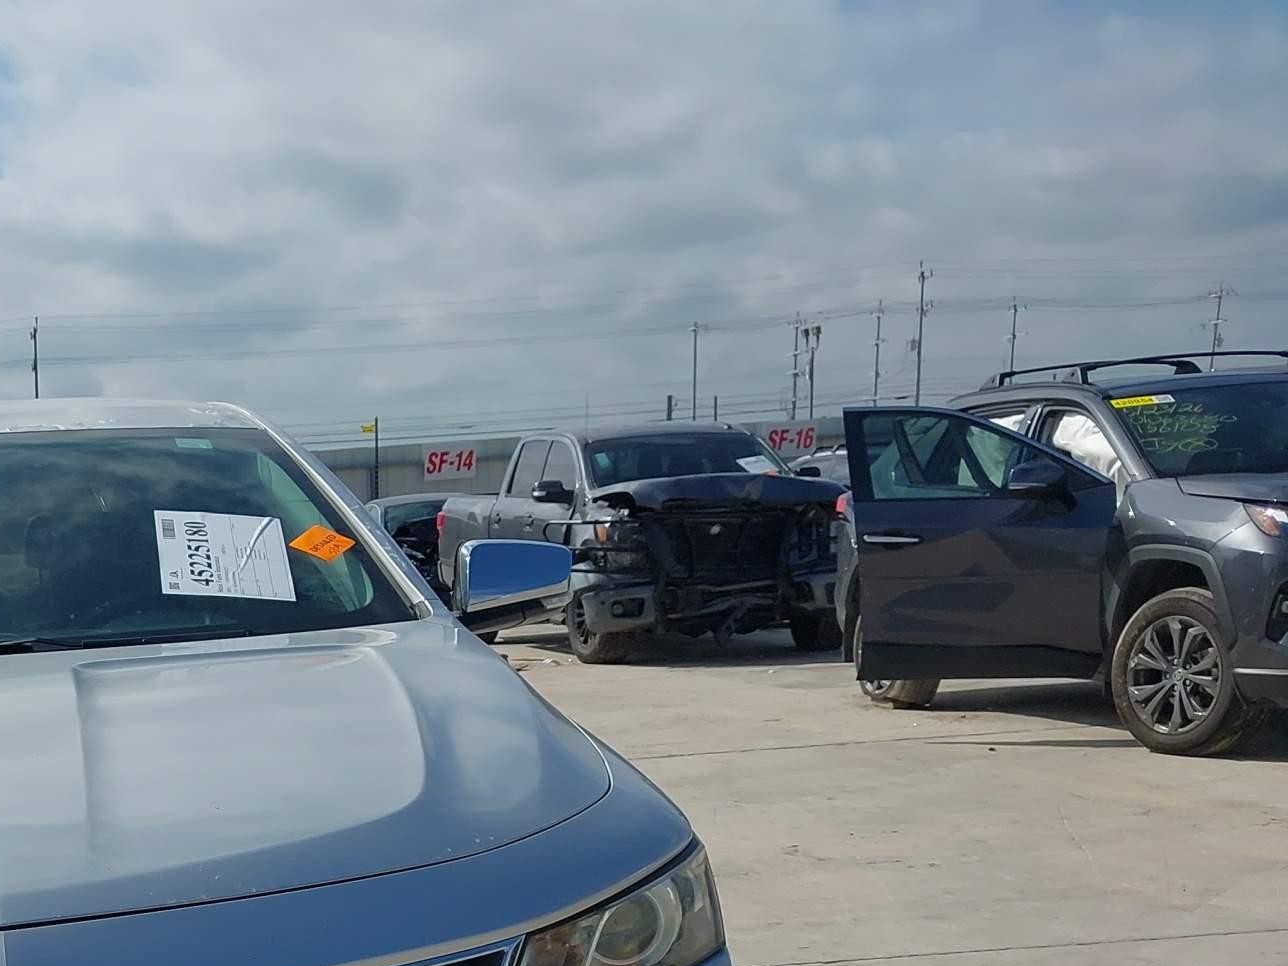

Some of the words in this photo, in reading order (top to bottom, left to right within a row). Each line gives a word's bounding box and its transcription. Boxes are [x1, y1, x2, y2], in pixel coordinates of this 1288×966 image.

[768, 427, 815, 451] SF-16
[426, 449, 474, 474] SF-14
[183, 521, 215, 587] 45225180
